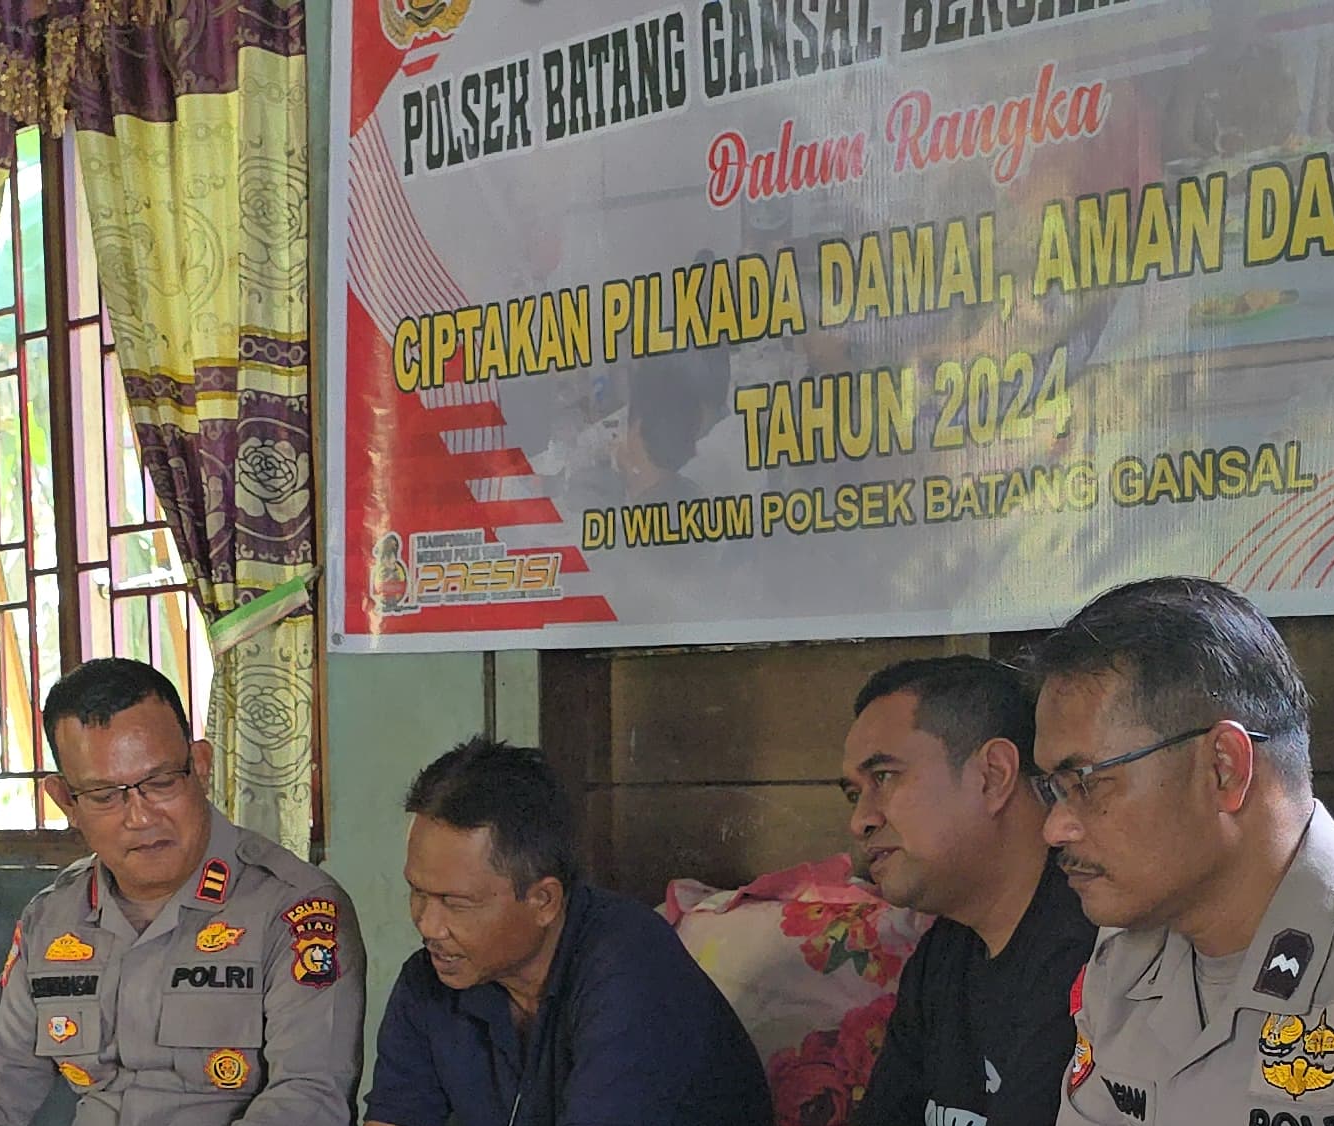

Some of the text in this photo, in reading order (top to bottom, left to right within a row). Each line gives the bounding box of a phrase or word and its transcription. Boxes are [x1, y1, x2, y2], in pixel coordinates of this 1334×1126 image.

[404, 58, 532, 176] POLSEK
[543, 12, 685, 141] BATANG
[701, 0, 881, 99] GANSAL
[708, 64, 1104, 207] Dalam Rangka
[393, 298, 593, 391] CIPTAKAN
[602, 249, 805, 362] PILKADA
[820, 214, 1012, 332] DAMAI,
[1033, 172, 1228, 299] AMAN
[736, 346, 1072, 469] TAHUN 2024
[582, 440, 1318, 550] DI WILKUM POLSEK BATANG GANSAL
[417, 556, 561, 594] PRESISI
[171, 965, 255, 990] POLRI
[296, 921, 335, 934] RIAU
